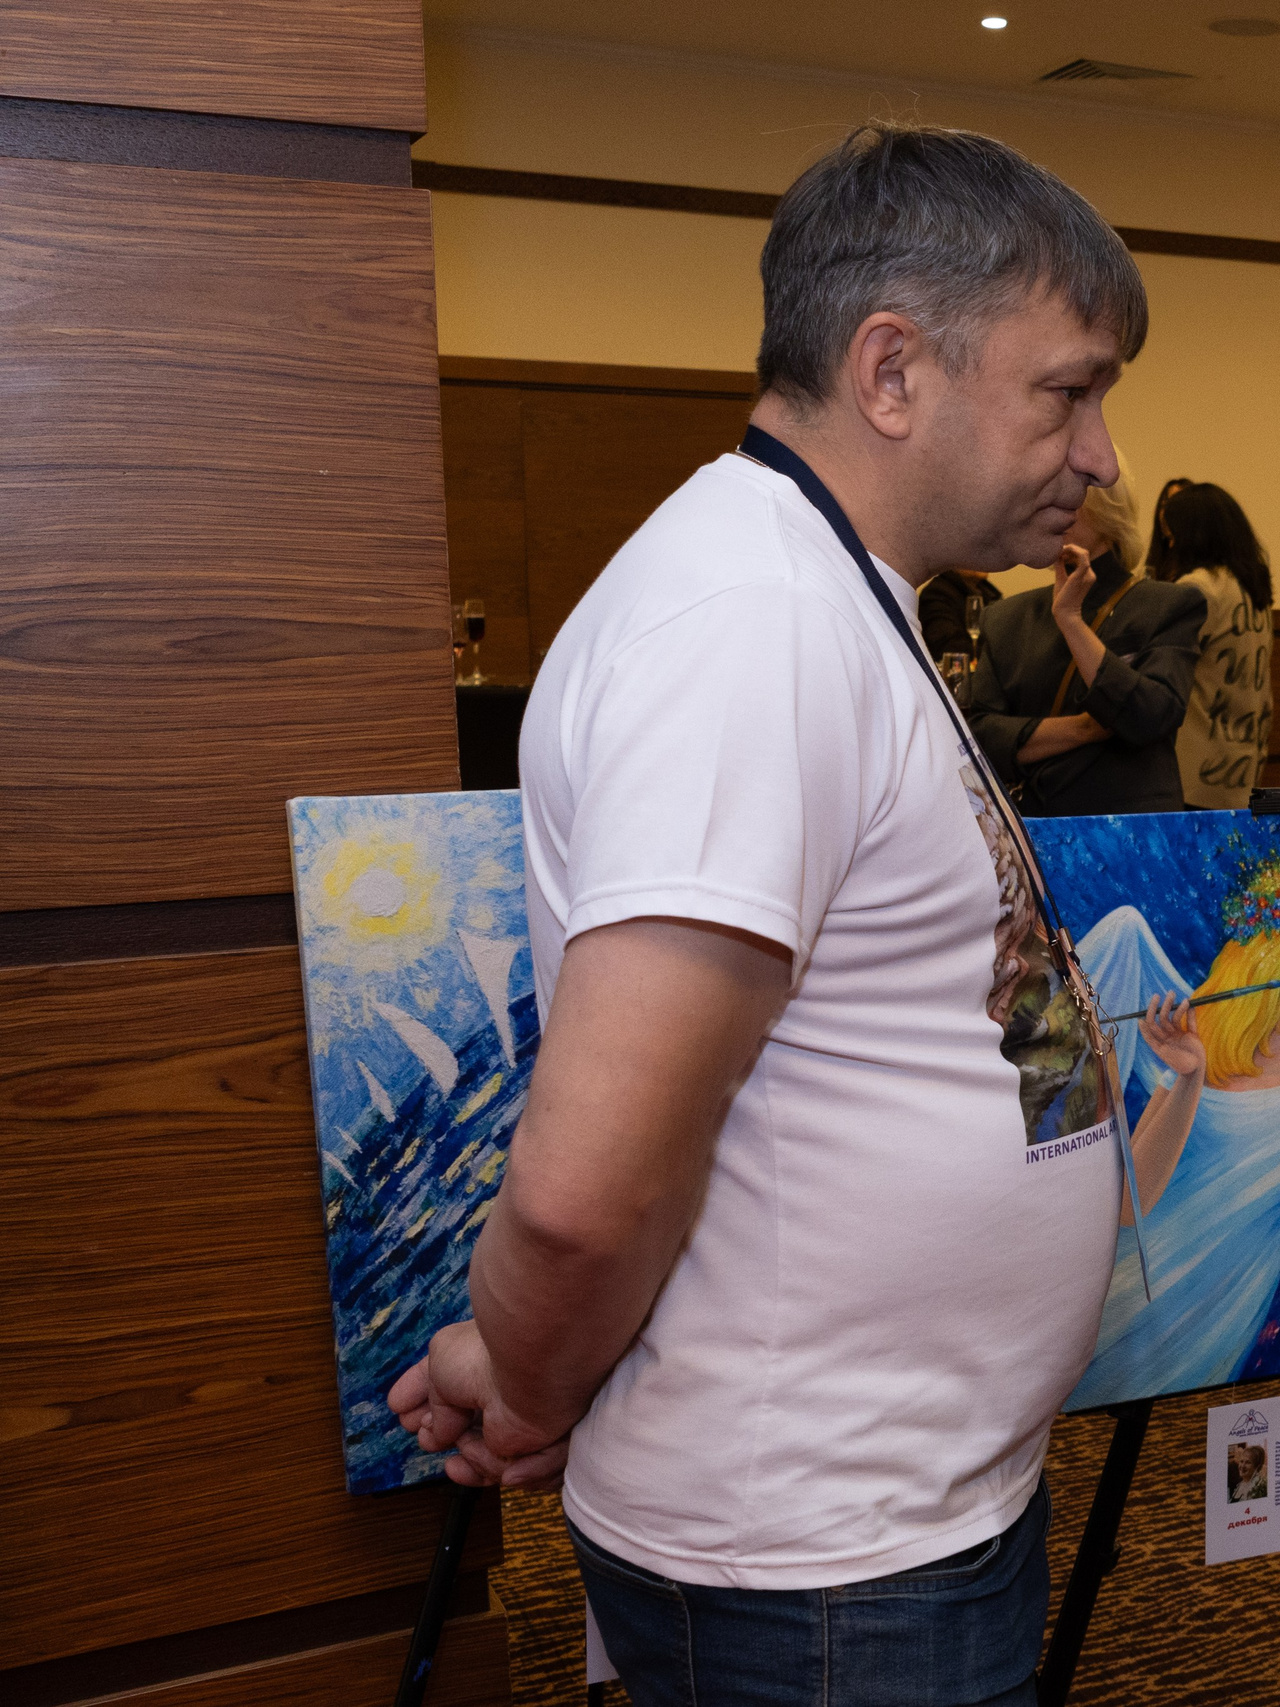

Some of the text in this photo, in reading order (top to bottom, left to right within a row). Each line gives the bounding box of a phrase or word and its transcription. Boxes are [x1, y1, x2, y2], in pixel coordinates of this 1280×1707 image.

[1026, 1125, 1109, 1164] INTERNATIONAL
[1228, 1428, 1247, 1438] Angels
[1254, 1424, 1269, 1432] Peace
[1244, 1507, 1251, 1515] 4
[1227, 1515, 1268, 1530] декабря
